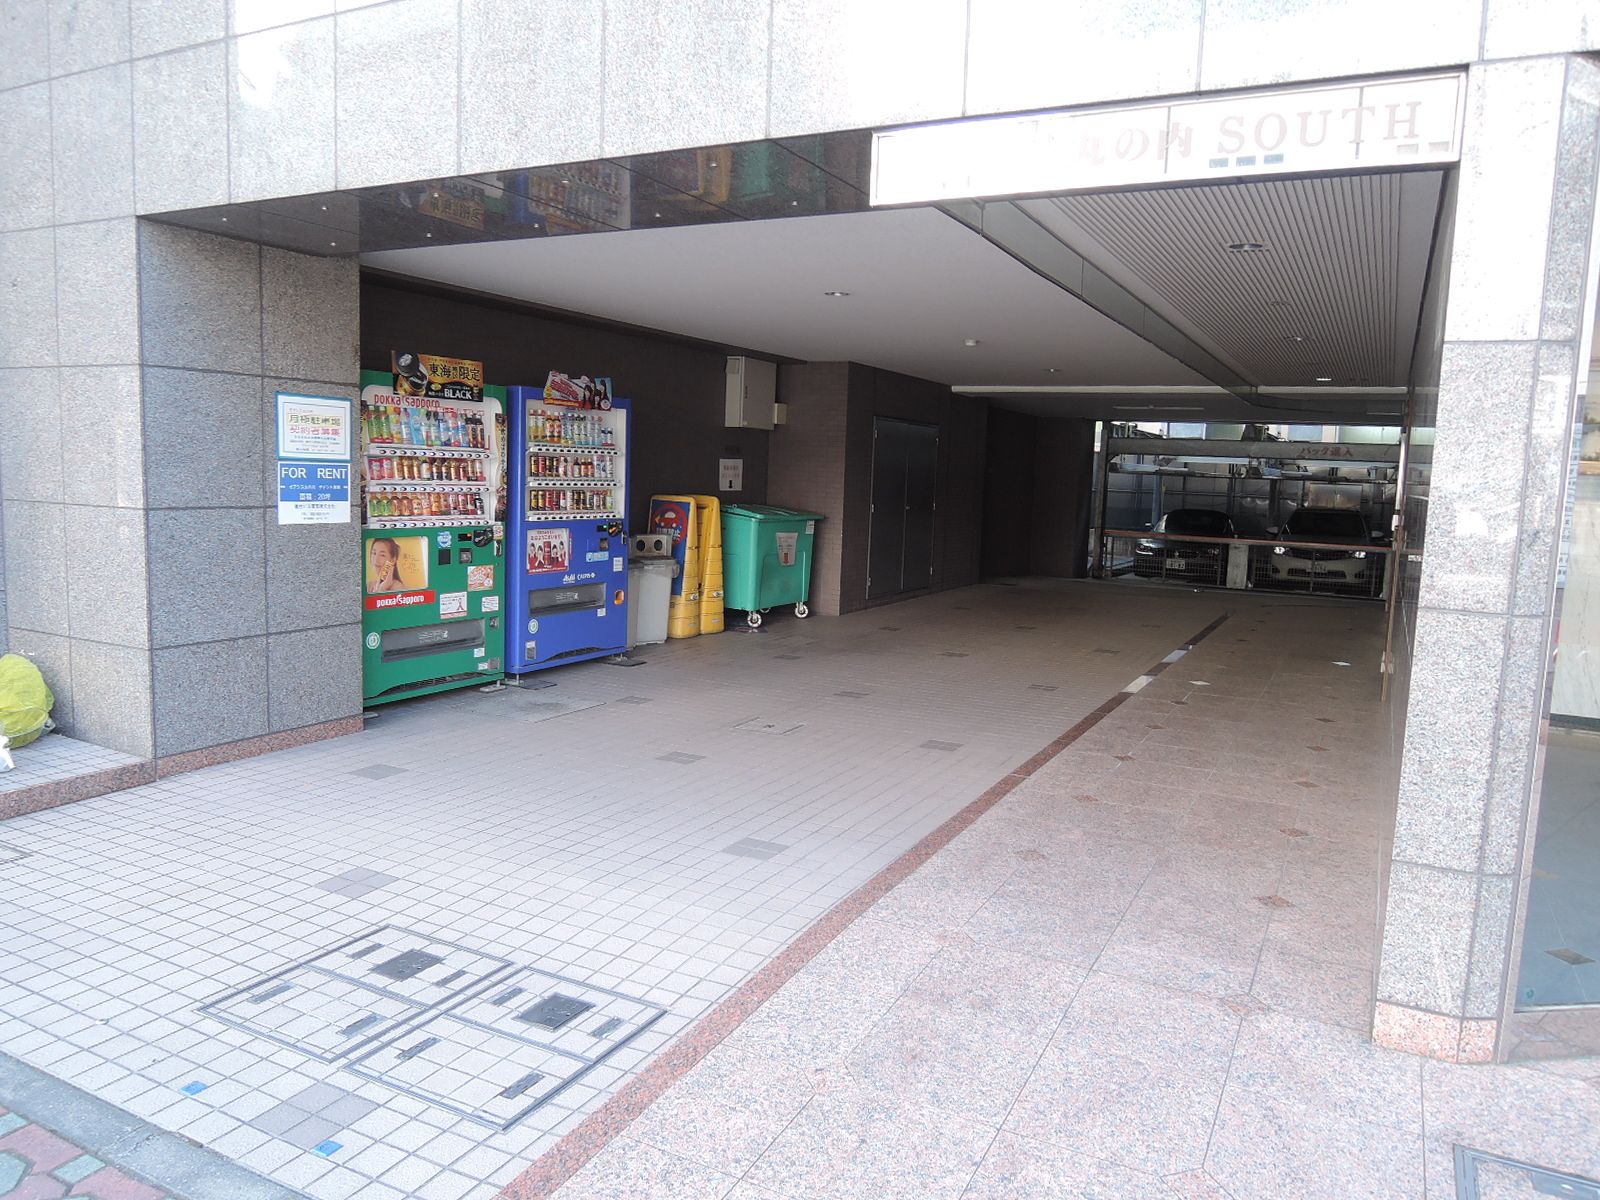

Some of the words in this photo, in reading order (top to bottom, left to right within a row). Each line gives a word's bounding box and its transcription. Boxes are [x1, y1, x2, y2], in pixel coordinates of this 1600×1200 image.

[1217, 101, 1422, 154] SOUTH
[444, 388, 473, 400] BLACK
[281, 467, 307, 479] FOR
[317, 468, 348, 480] RENT
